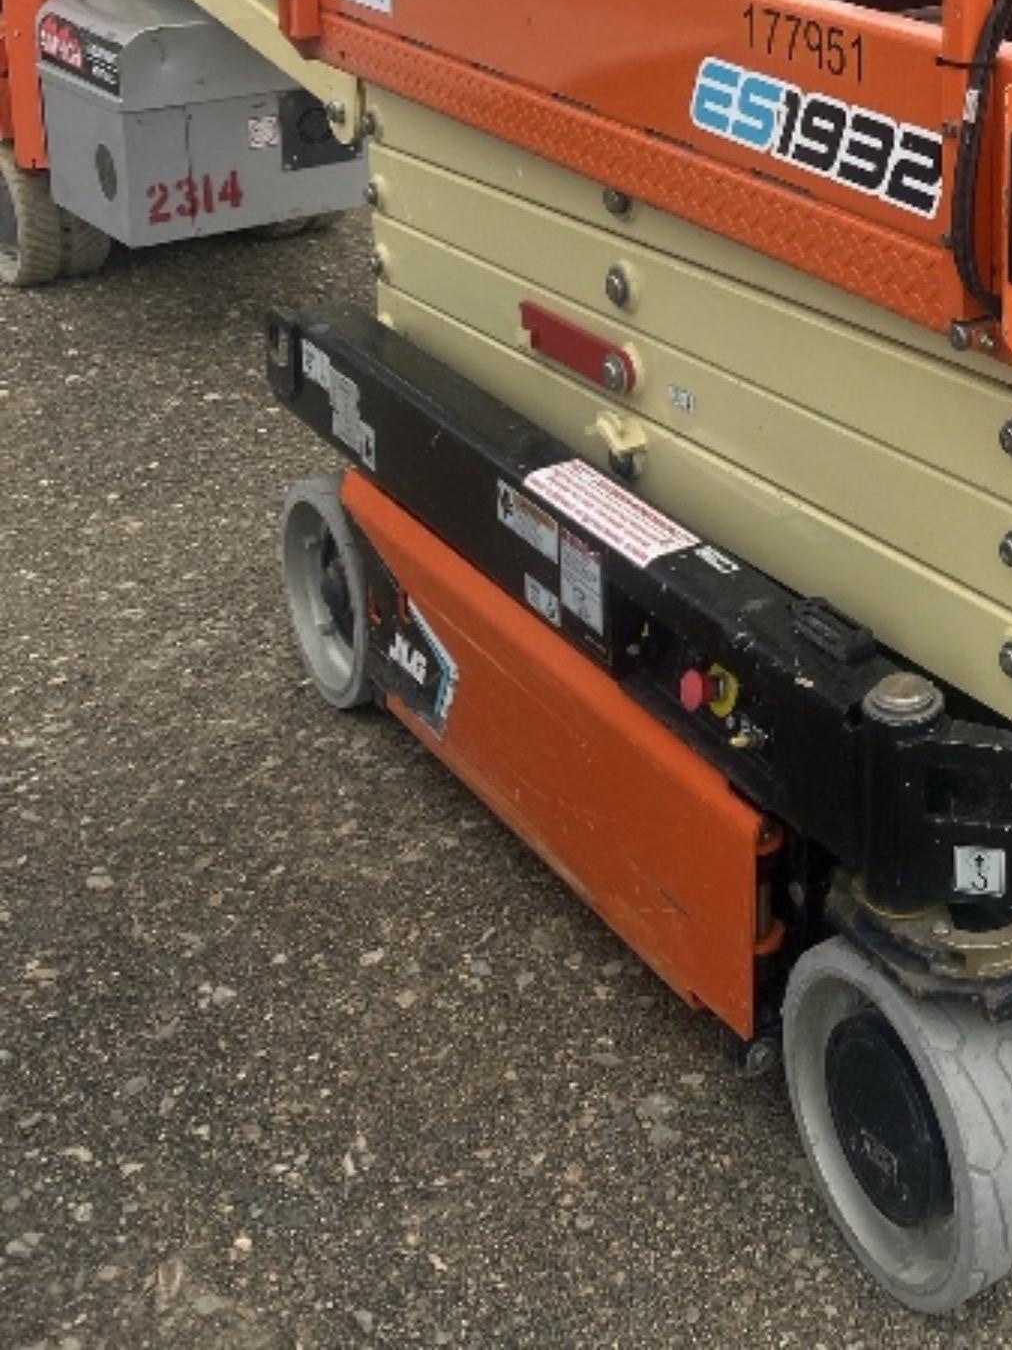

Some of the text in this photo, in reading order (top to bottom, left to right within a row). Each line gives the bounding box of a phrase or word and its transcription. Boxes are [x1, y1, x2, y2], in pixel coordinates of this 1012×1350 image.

[743, 3, 864, 83] 177951
[691, 57, 943, 219] ES1932
[146, 169, 244, 226] 2314
